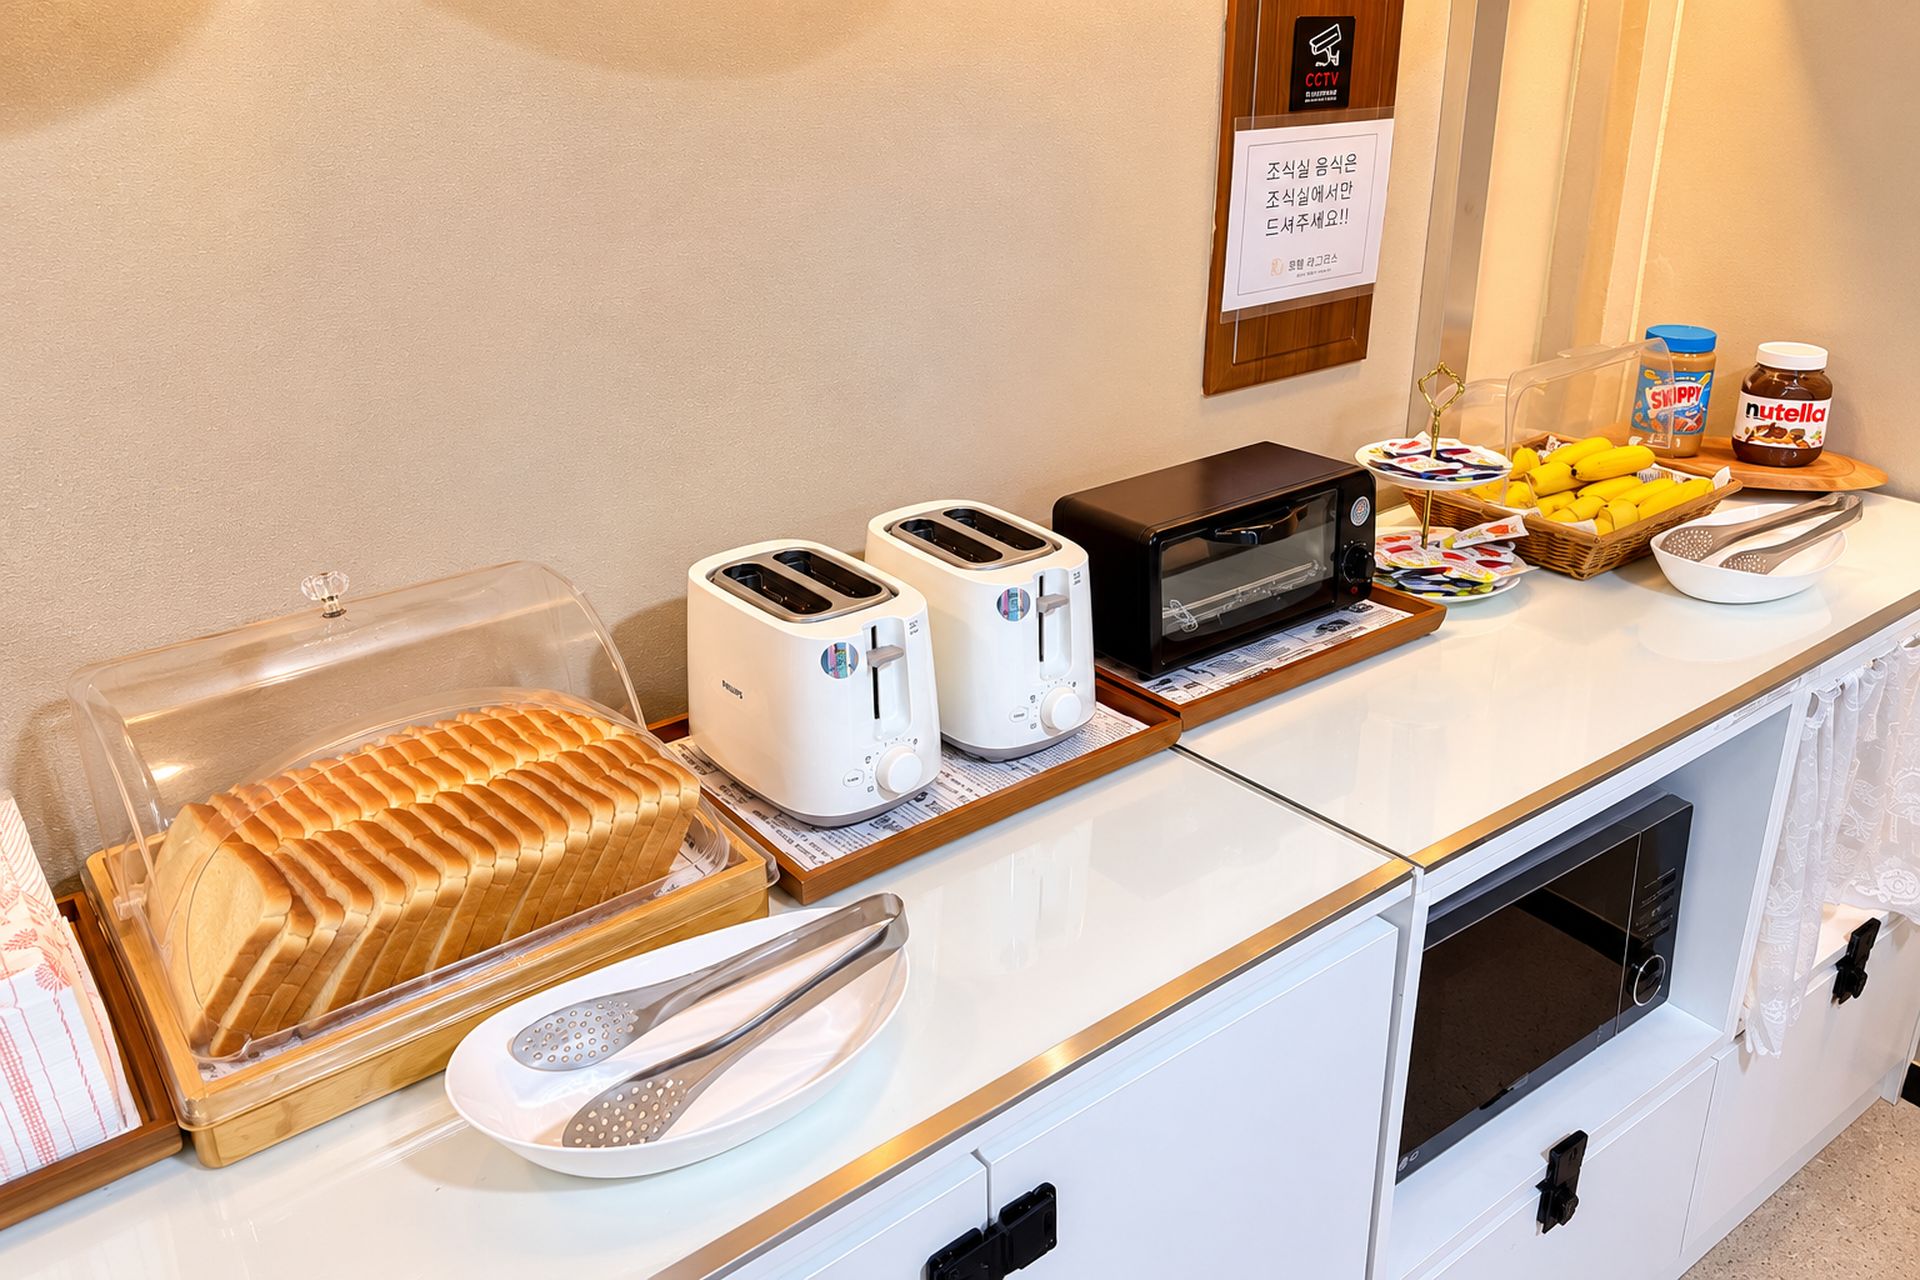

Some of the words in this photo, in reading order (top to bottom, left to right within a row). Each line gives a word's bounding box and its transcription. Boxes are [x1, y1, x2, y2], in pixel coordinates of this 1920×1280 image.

[1305, 71, 1339, 87] CCTV
[1266, 158, 1310, 180] 조식실
[1315, 153, 1357, 176] 음식은
[1265, 180, 1353, 209] 조식실에서만
[1265, 208, 1349, 236] 드셔주세요!!
[1651, 386, 1701, 409] SKIPPY
[1745, 402, 1826, 423] nutella
